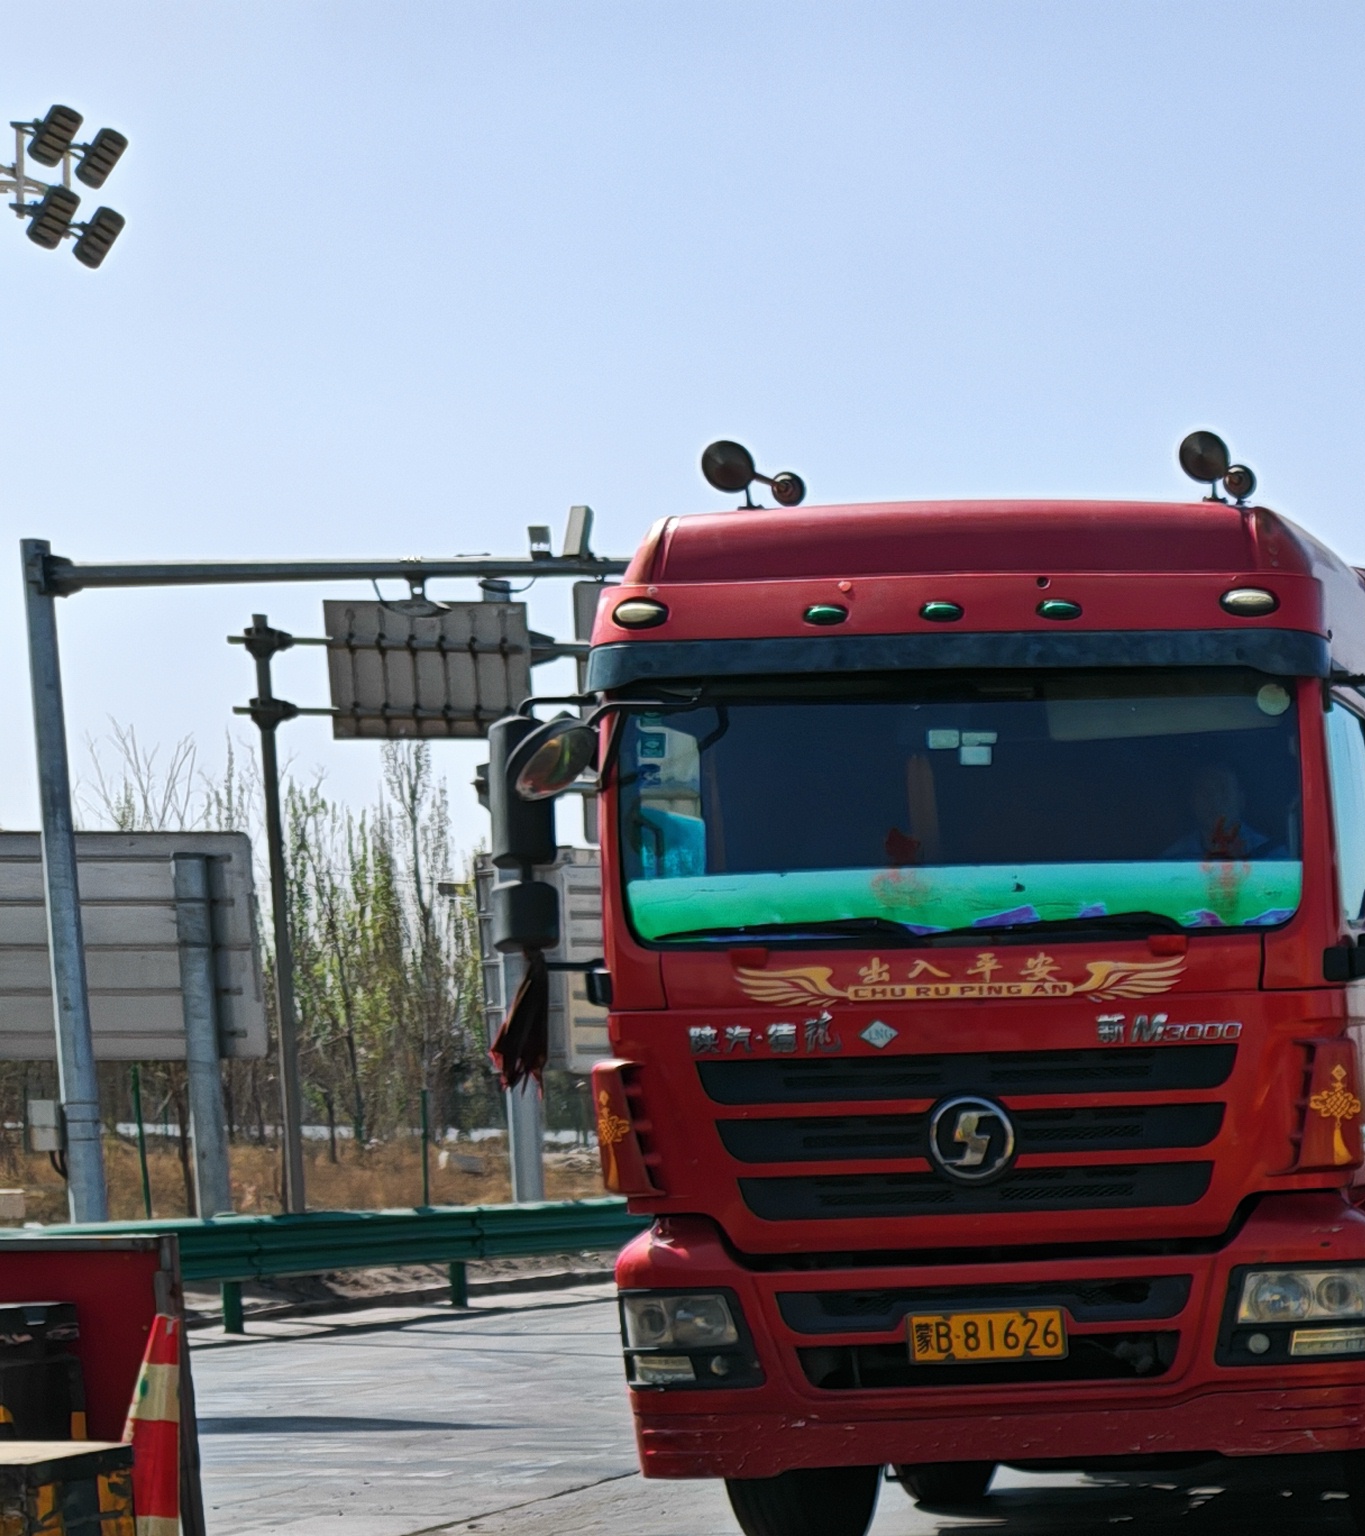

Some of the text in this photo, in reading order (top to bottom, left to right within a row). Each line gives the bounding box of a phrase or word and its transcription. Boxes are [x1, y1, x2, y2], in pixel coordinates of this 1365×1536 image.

[858, 951, 1062, 984] 出入平安
[853, 983, 1069, 999] CHU RU PING AN
